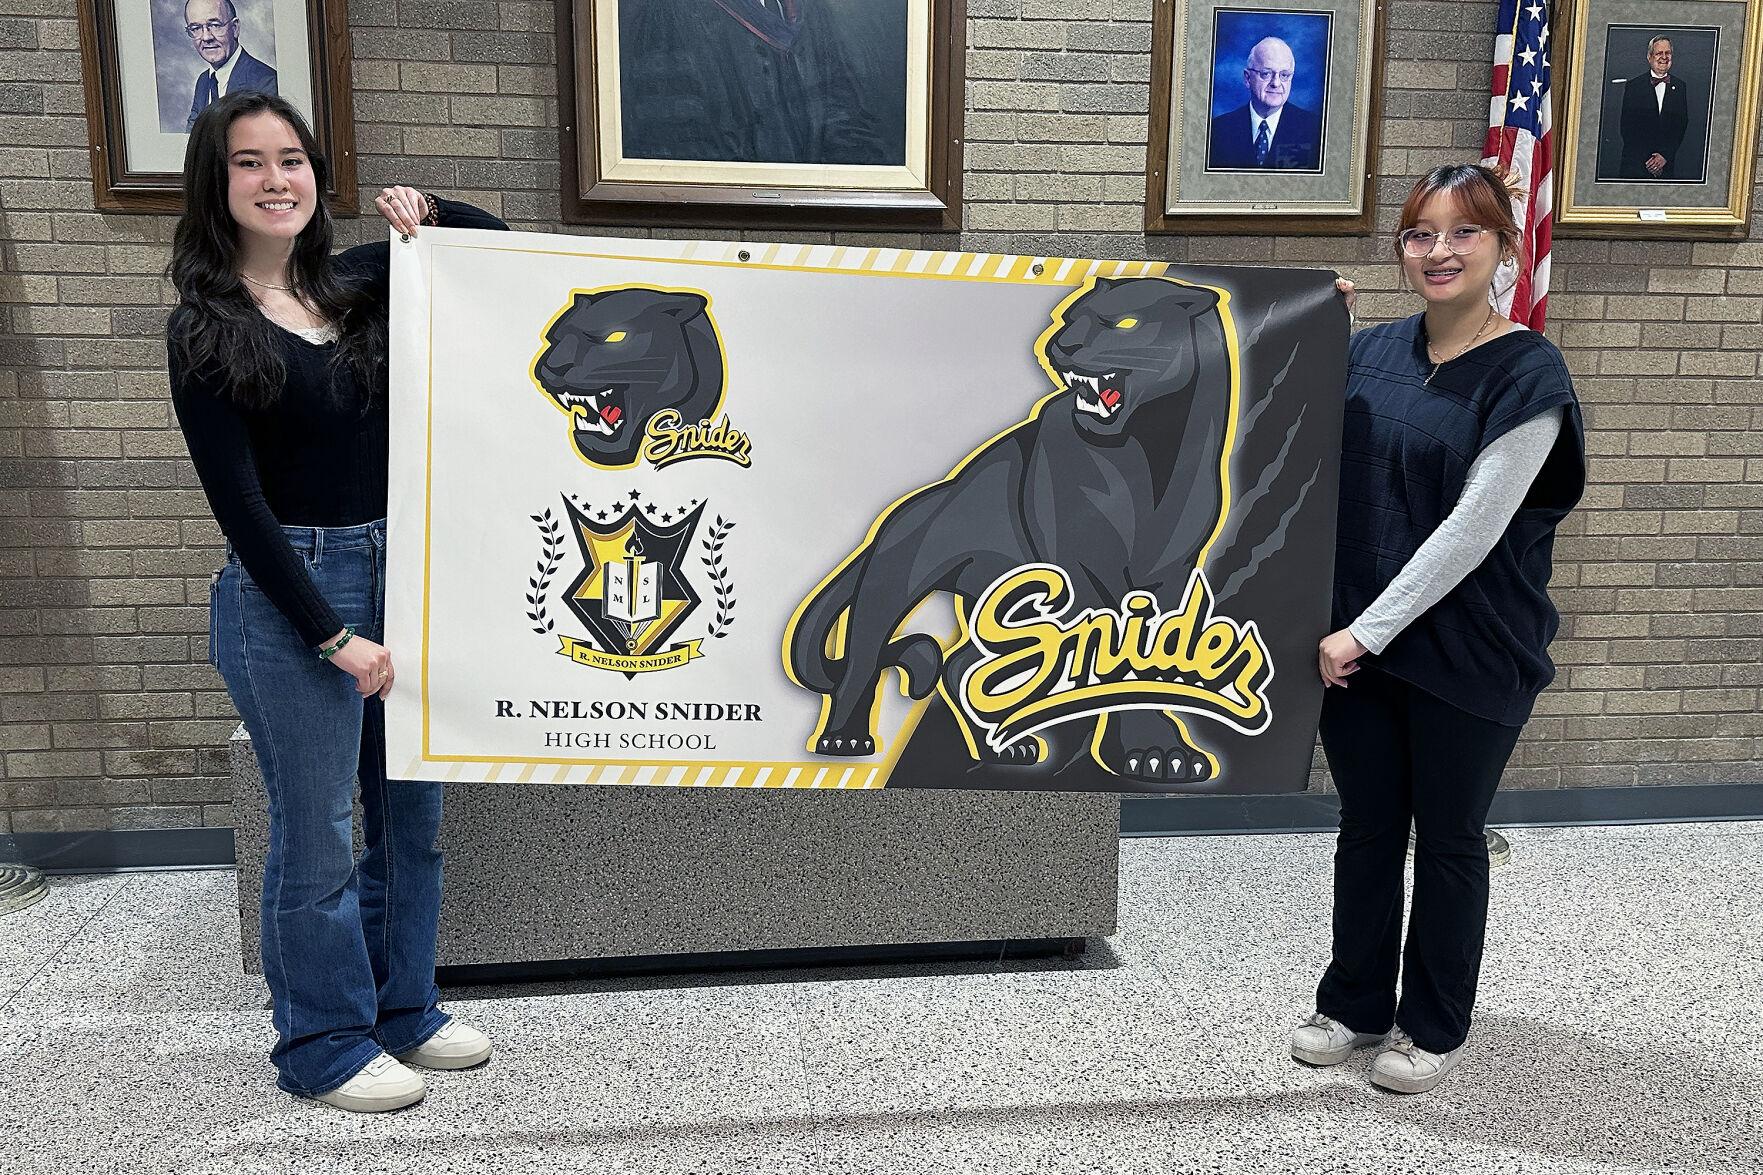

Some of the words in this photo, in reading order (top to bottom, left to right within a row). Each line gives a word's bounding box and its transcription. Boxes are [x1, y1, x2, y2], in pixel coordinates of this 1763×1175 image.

[644, 409, 752, 471] Snider
[614, 576, 624, 585] N
[643, 576, 650, 586] S
[613, 594, 624, 604] M
[642, 594, 650, 604] L
[579, 651, 591, 661] R.
[592, 656, 637, 668] NELSON
[639, 654, 682, 668] SNIDER
[961, 564, 1273, 748] Snider
[495, 699, 522, 718] R.
[528, 700, 648, 720] NELSON
[654, 703, 763, 722] SNIDER
[544, 732, 611, 749] HIGH
[619, 733, 717, 750] SCHOOL
